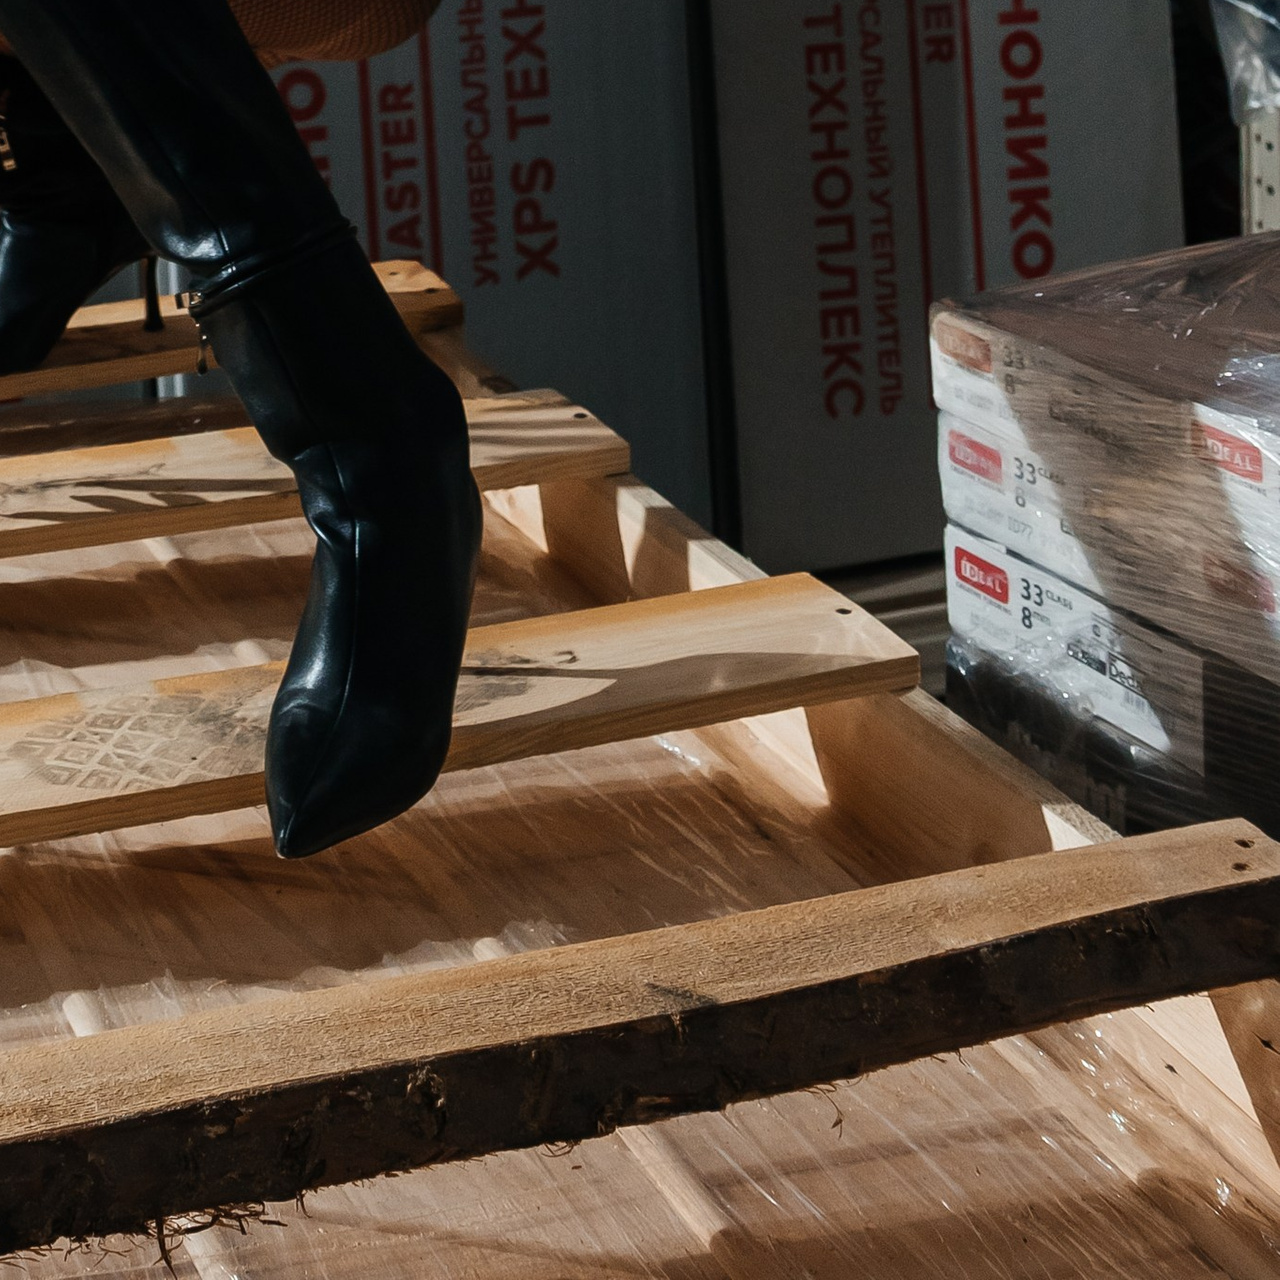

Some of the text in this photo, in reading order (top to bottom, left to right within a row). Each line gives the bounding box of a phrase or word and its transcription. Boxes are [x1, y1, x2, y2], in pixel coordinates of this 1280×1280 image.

[378, 82, 422, 260] ASTER
[803, 3, 865, 419] ТЕХНОПЛЕКС
[511, 156, 561, 282] XPS
[868, 184, 903, 417] УТЕПЛИТЕЛЬ
[1014, 457, 1037, 485] 33
[960, 556, 1003, 594] IDEAL
[1021, 578, 1044, 607] 33
[1021, 606, 1034, 630] 8
